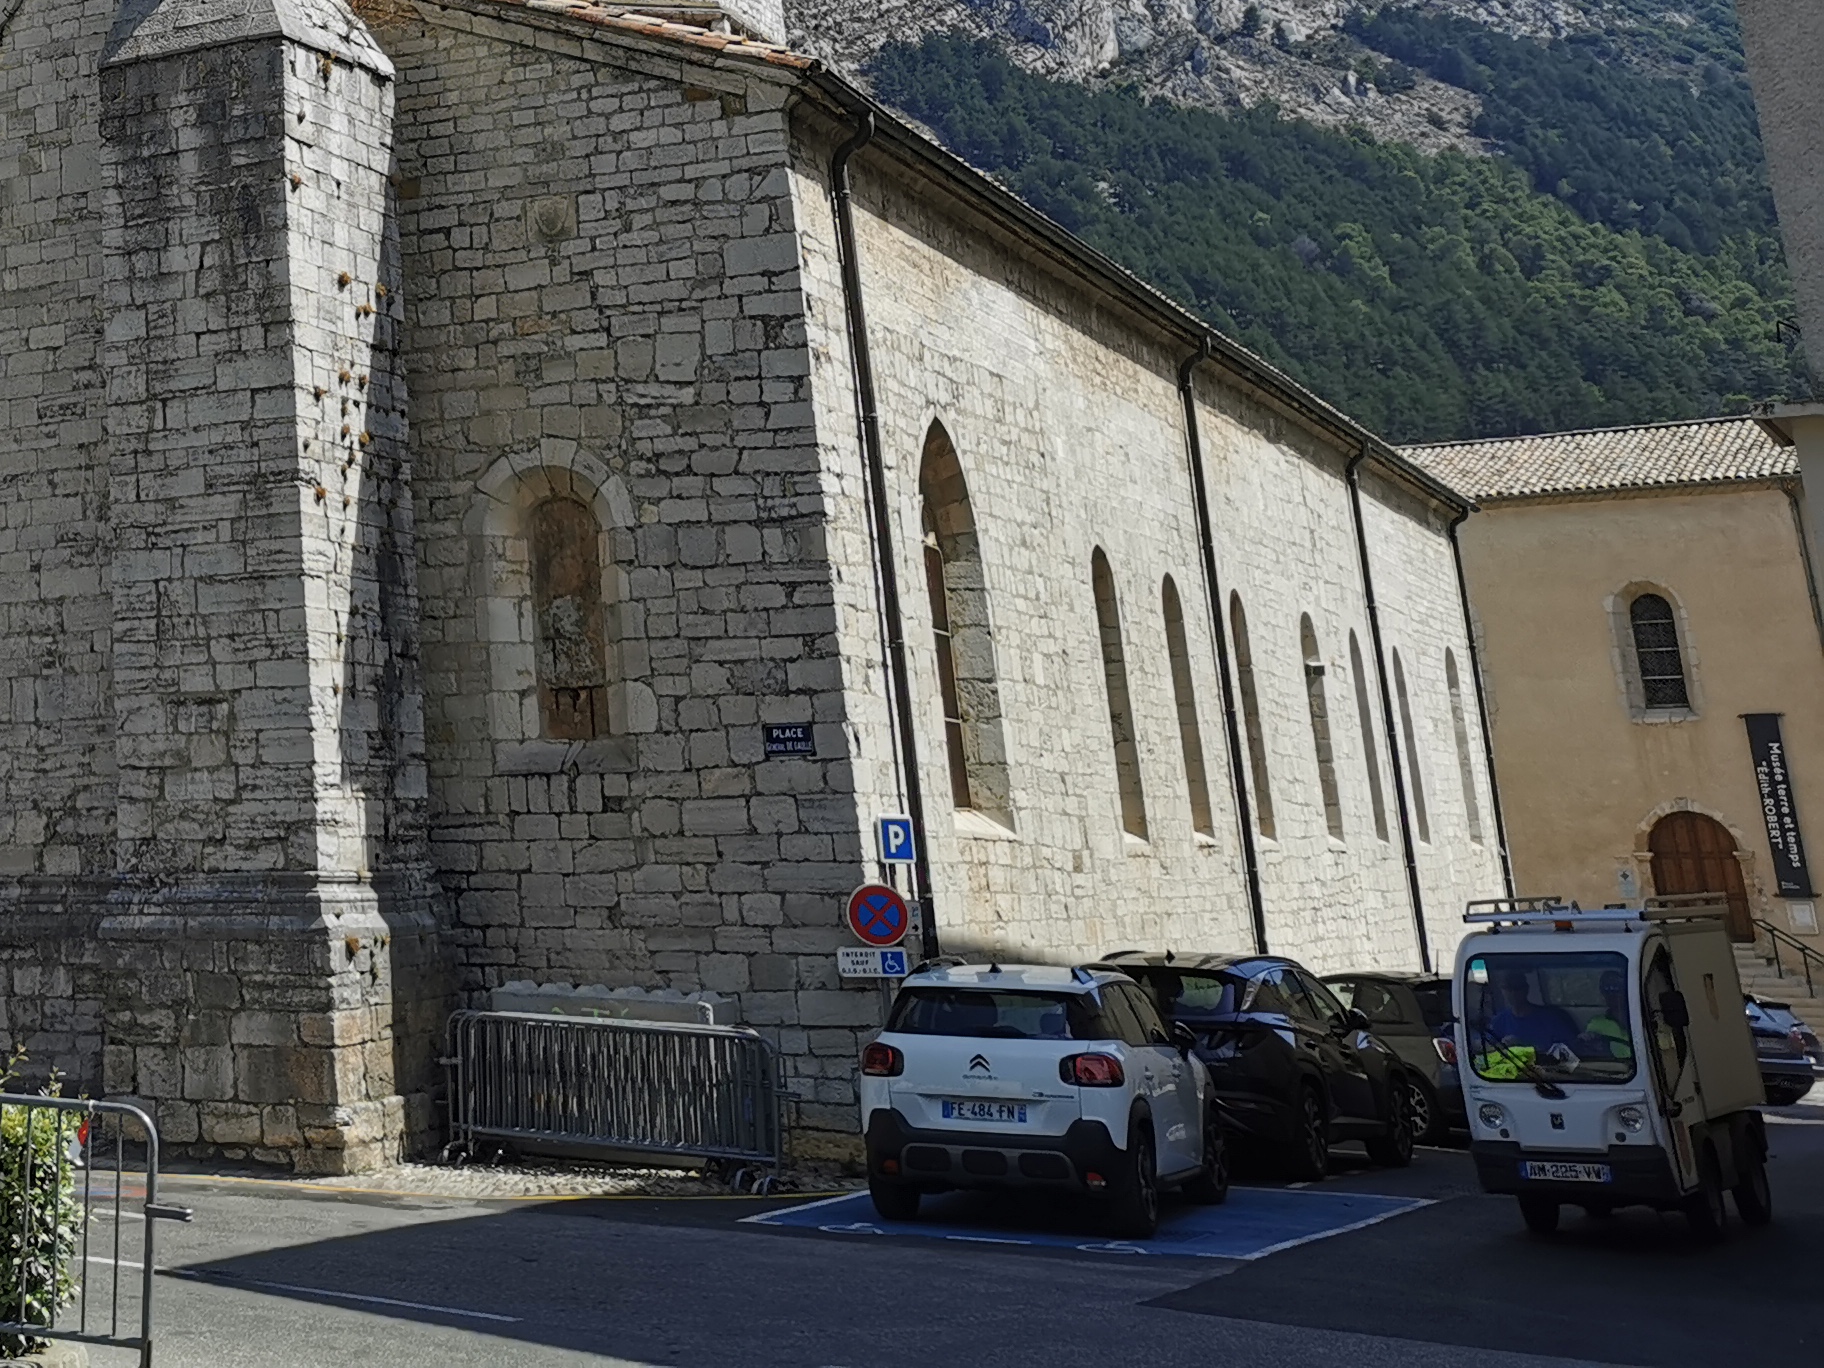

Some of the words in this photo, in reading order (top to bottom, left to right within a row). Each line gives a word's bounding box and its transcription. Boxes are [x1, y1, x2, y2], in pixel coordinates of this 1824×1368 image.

[772, 727, 804, 739] PLACE
[1768, 742, 1784, 781] Musée
[1777, 784, 1790, 814] terre
[1783, 817, 1795, 830] et
[887, 824, 905, 854] P
[1786, 831, 1802, 868] temps
[950, 1102, 1016, 1119] FE-484-FN
